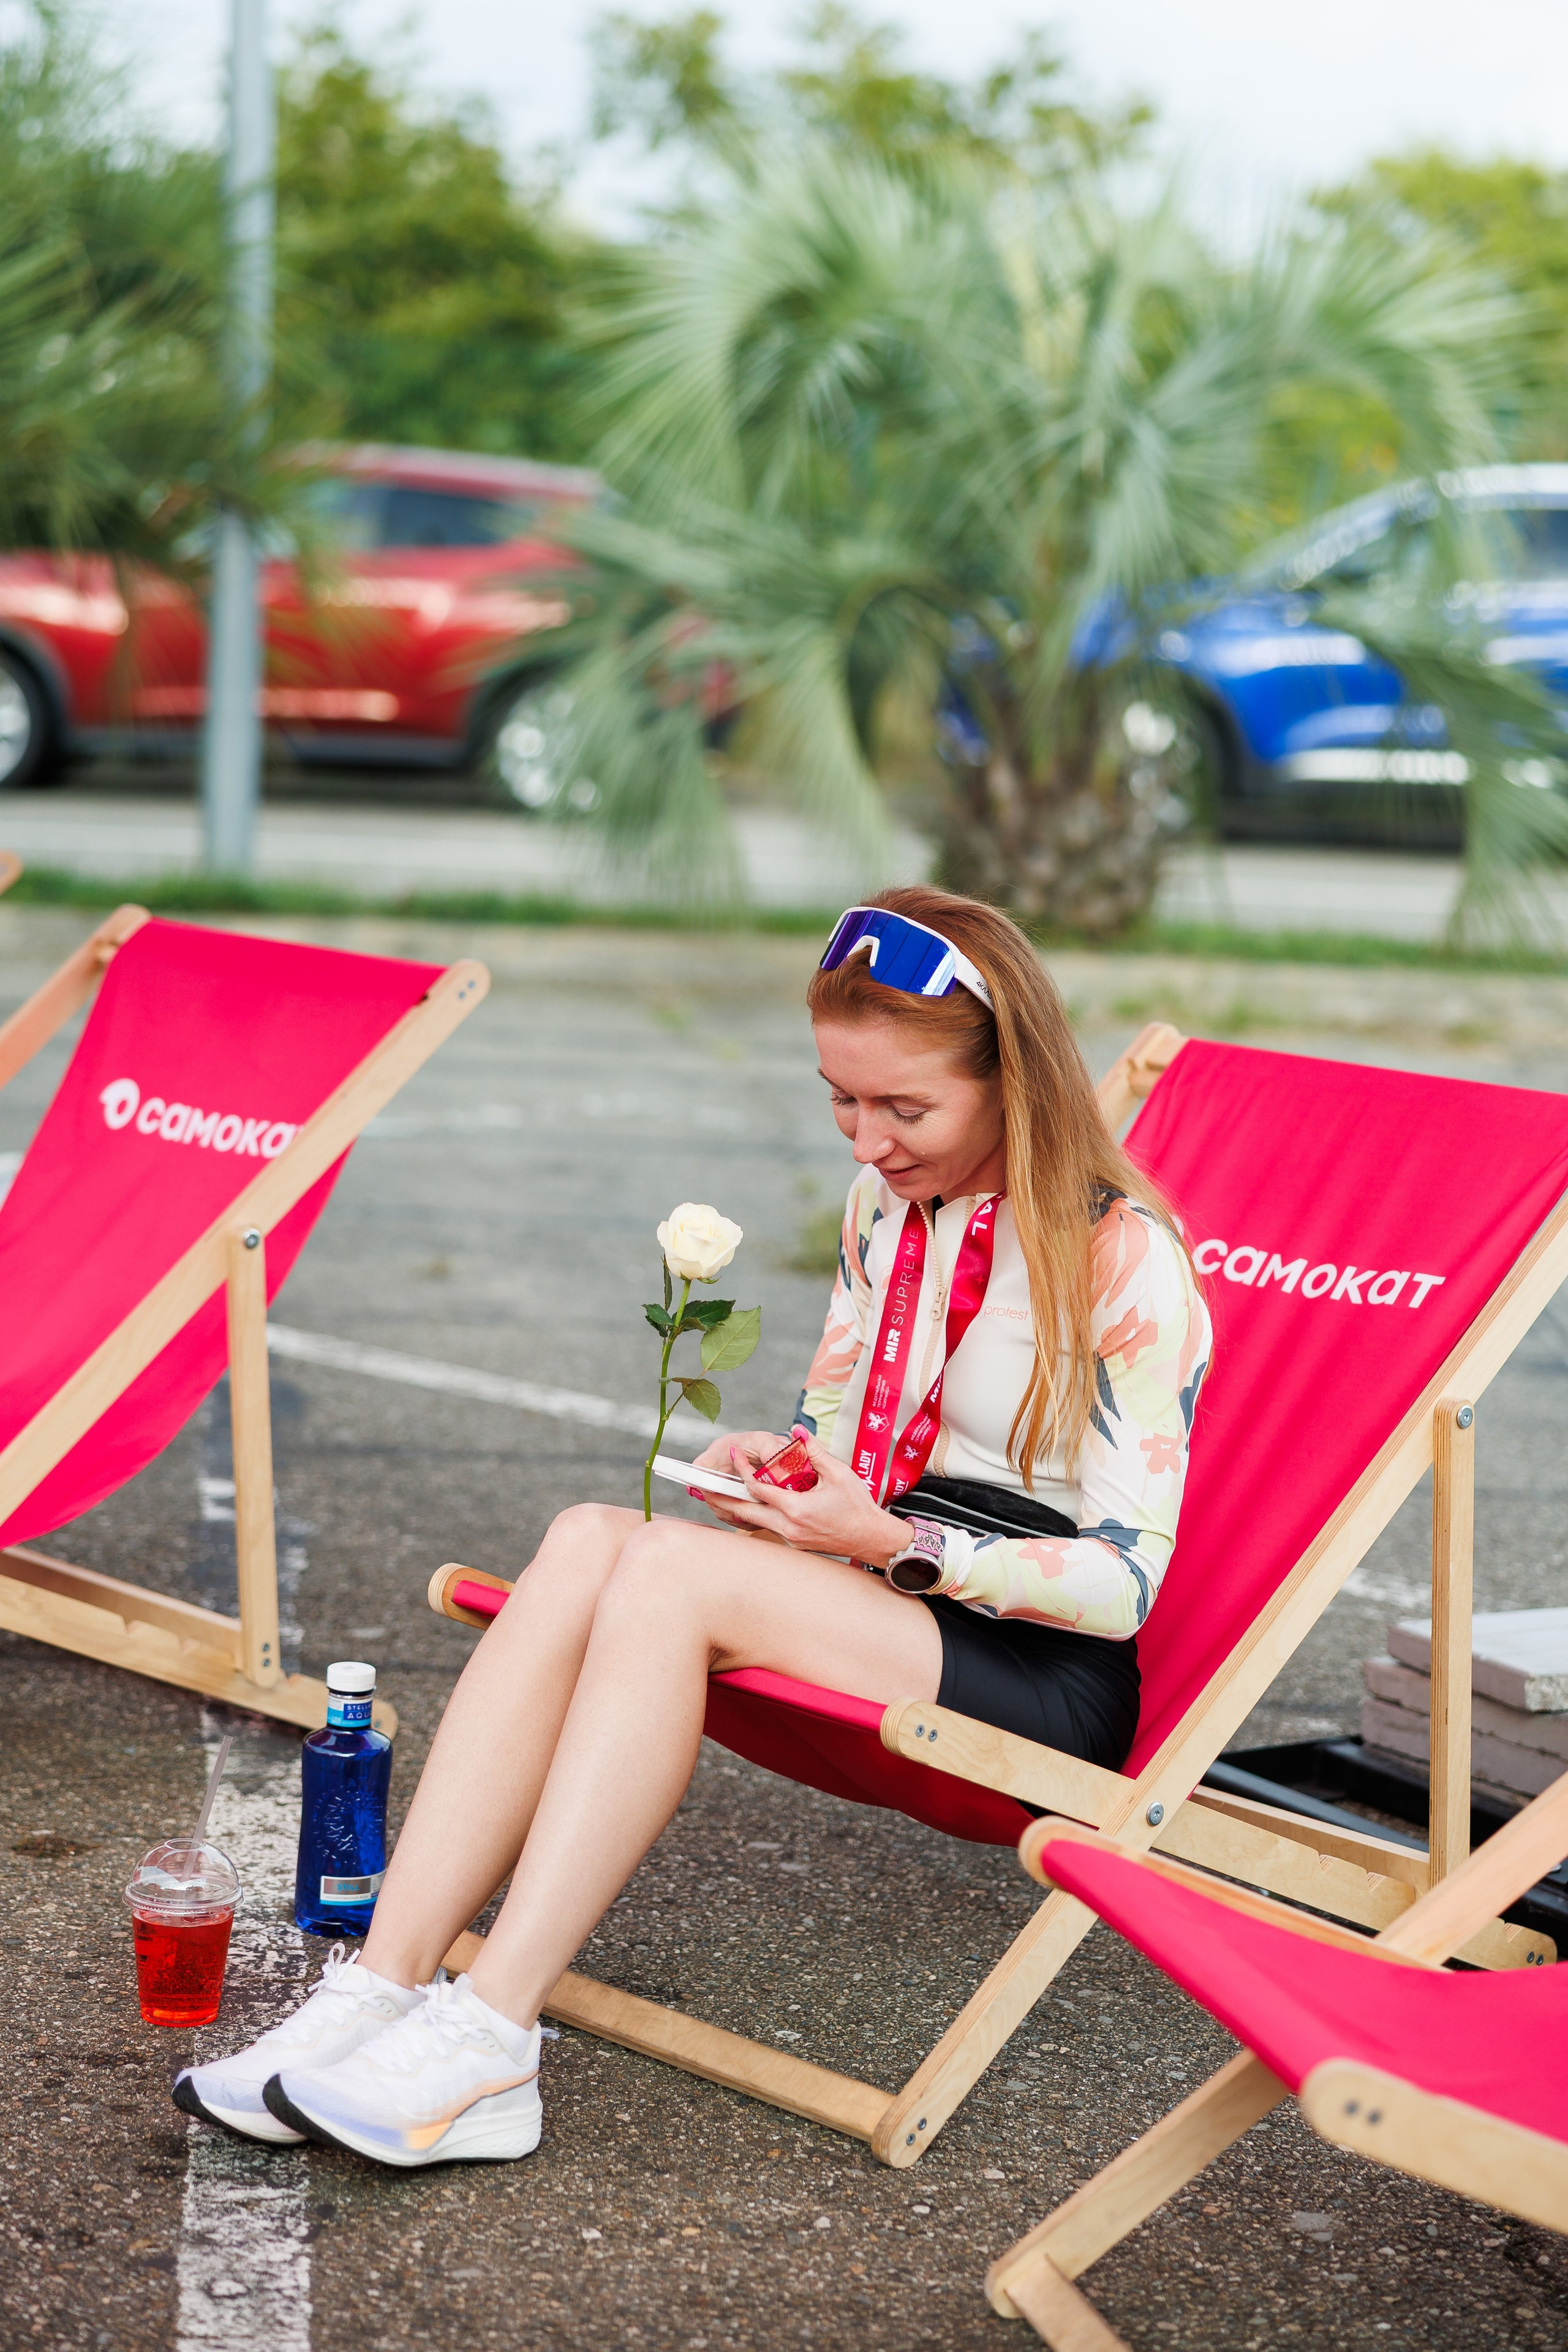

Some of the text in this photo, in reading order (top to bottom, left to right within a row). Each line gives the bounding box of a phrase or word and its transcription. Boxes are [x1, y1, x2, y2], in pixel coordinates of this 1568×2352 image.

[135, 1096, 304, 1159] самока
[1192, 1238, 1446, 1309] самокат
[883, 1227, 919, 1362] MIR SUPREME
[984, 1305, 1029, 1320] protest
[872, 1374, 882, 1407] ФЕДЕРАЛЬНАЯ
[877, 1379, 886, 1408] ТЕРРИТОРИЯ
[858, 1449, 872, 1475] LADY
[891, 1478, 905, 1498] ADY
[347, 1711, 370, 1719] AQU
